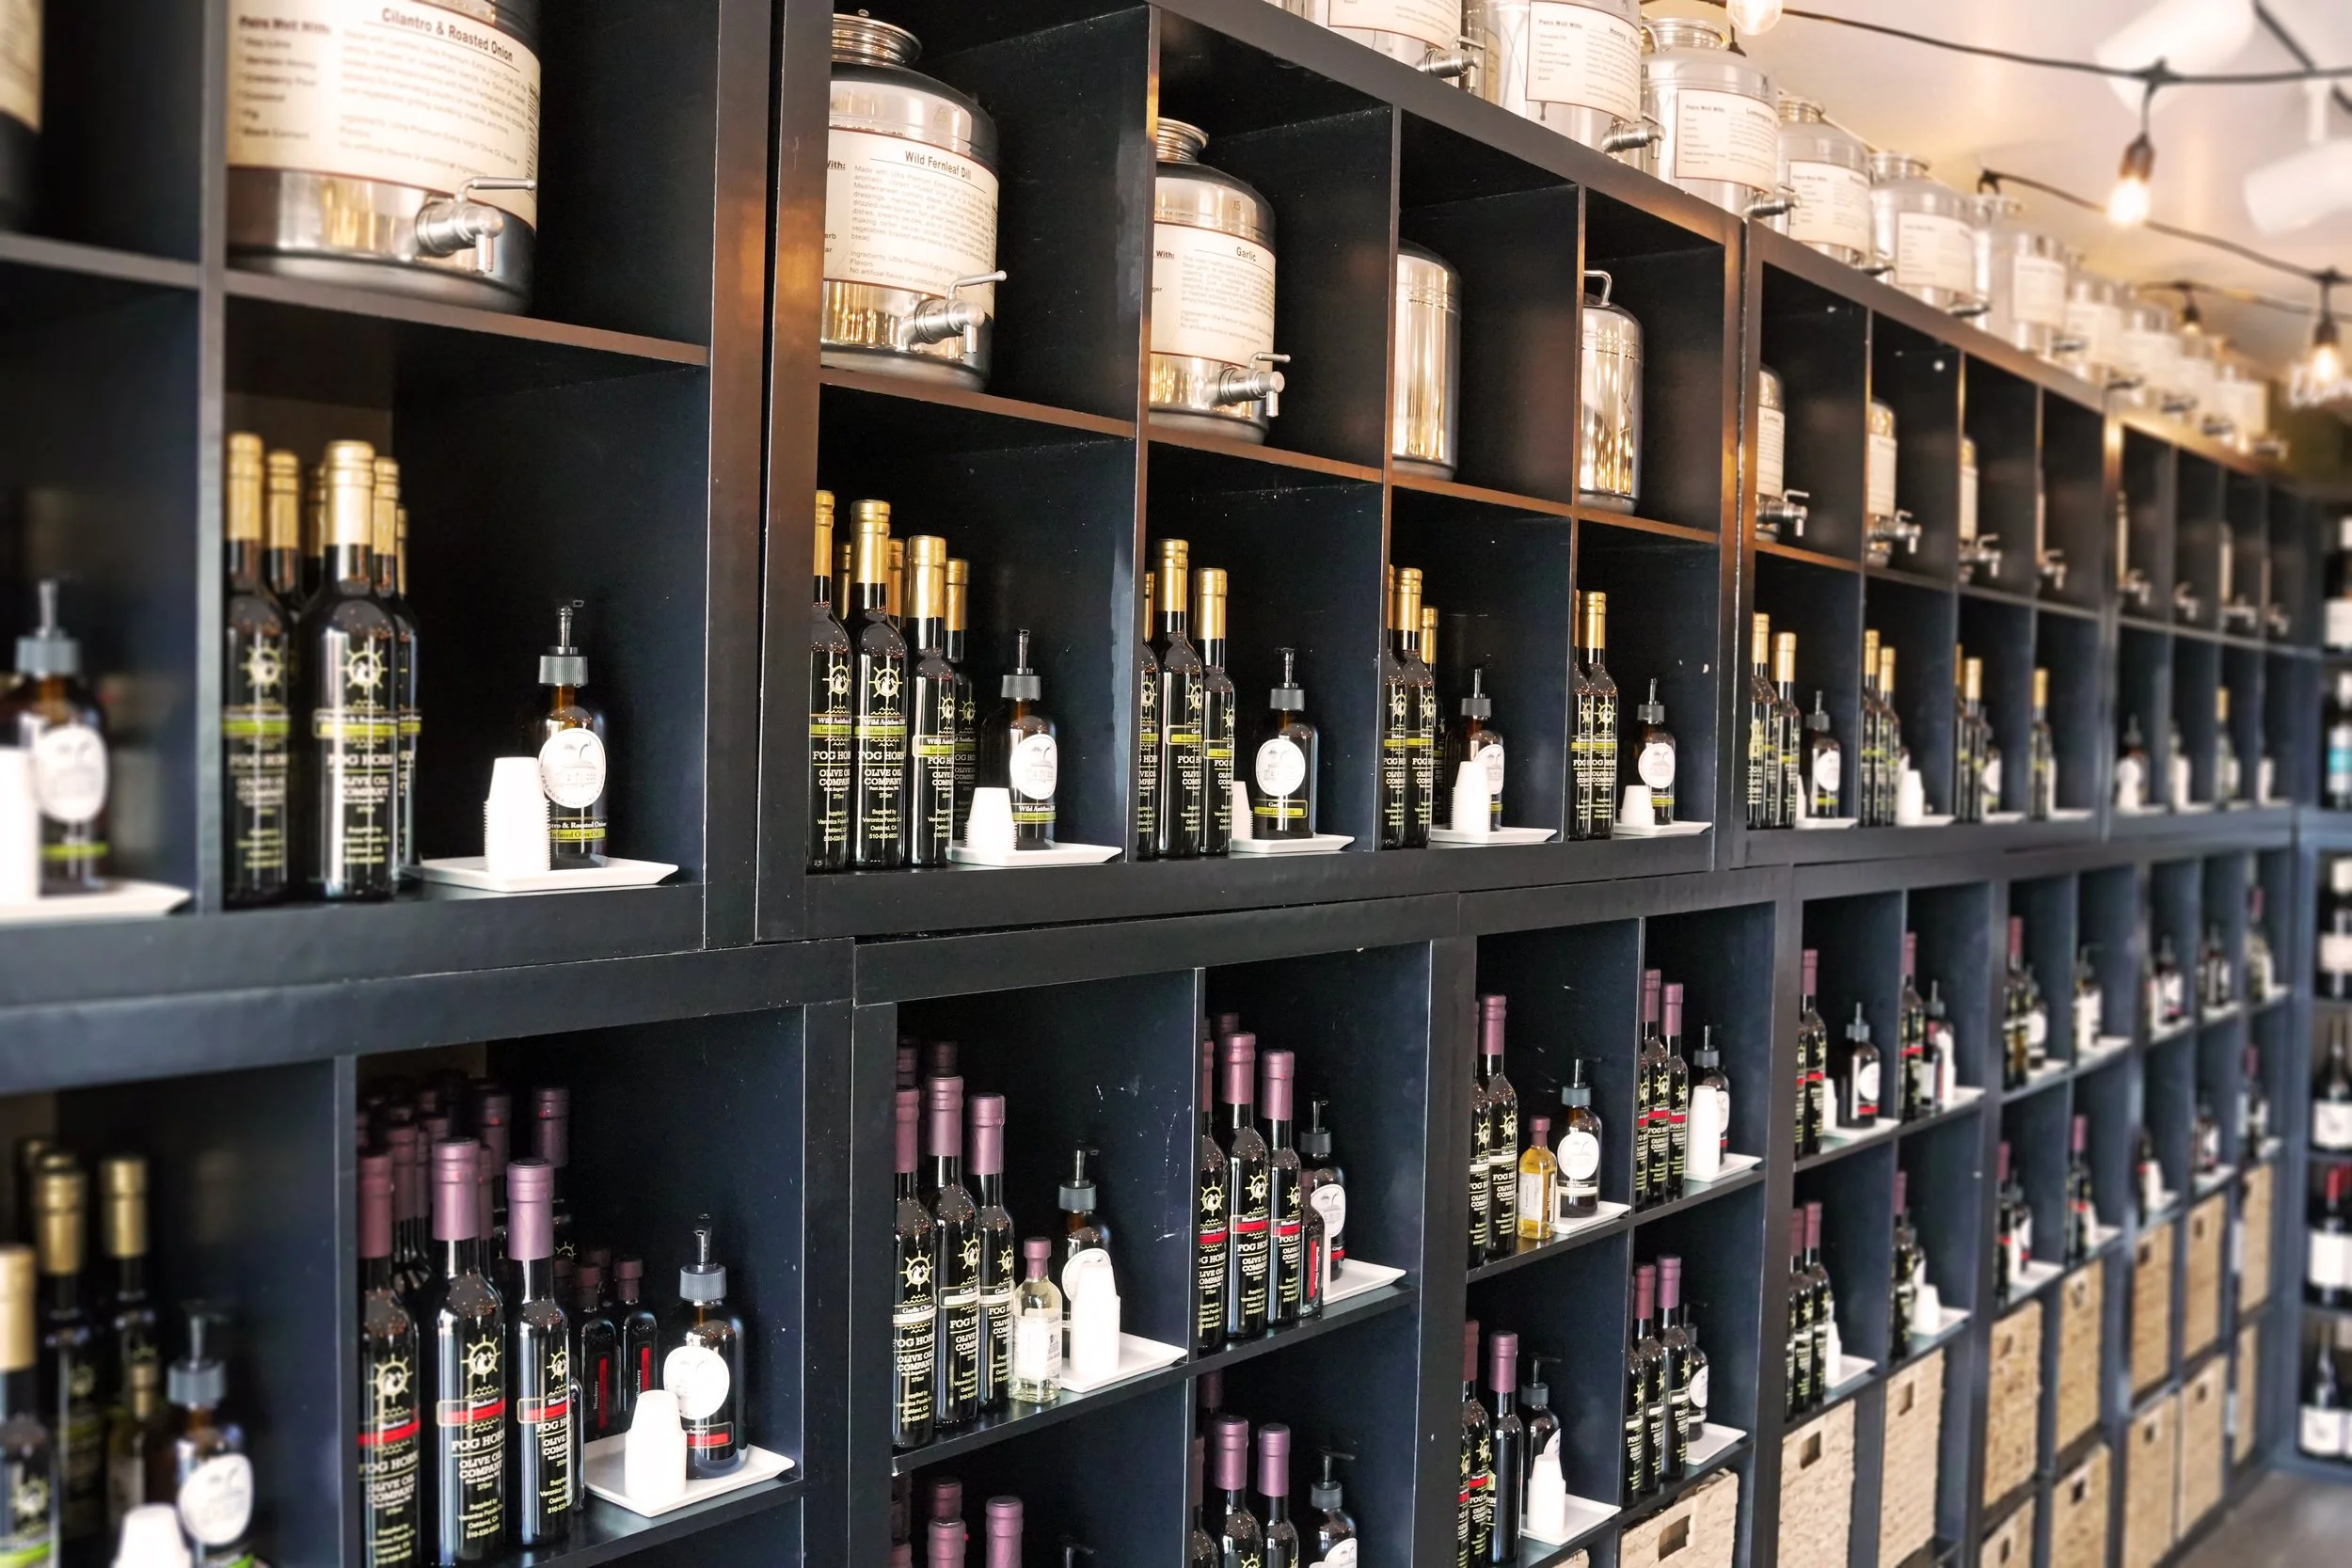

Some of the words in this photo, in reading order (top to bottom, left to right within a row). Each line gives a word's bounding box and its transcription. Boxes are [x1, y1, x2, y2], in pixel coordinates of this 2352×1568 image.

[382, 8, 432, 32] Cilantro
[437, 21, 444, 36] &
[448, 24, 489, 51] Roasted
[491, 40, 514, 62] Onion
[1609, 26, 1627, 41] Honey
[854, 166, 873, 174] Made
[905, 150, 925, 165] Wild
[928, 156, 960, 176] Fernleaf
[961, 166, 971, 181] Dill
[1155, 250, 1174, 260] With:
[1236, 246, 1257, 261] Garlic
[850, 258, 873, 267] Flavors
[813, 751, 835, 760] FOG
[858, 751, 882, 760] FOG
[928, 756, 946, 765] FOG
[864, 777, 901, 786] COMPANY
[1237, 1243, 1257, 1252] FOG
[1199, 1275, 1223, 1285] OMPANY
[902, 1306, 920, 1315] Garlic
[989, 1306, 1005, 1315] FOG
[950, 1318, 971, 1329] FOG
[956, 1332, 976, 1343] OLIVE
[897, 1353, 923, 1364] OLIVE
[536, 1420, 559, 1433] FOG
[452, 1437, 480, 1451] FOG
[543, 1434, 566, 1447] OLIVE
[459, 1456, 490, 1469] OLIVE
[491, 1450, 502, 1462] OIL
[459, 1460, 502, 1480] COMPANY
[469, 1499, 491, 1511] Supplied
[458, 1513, 484, 1522] Veronica
